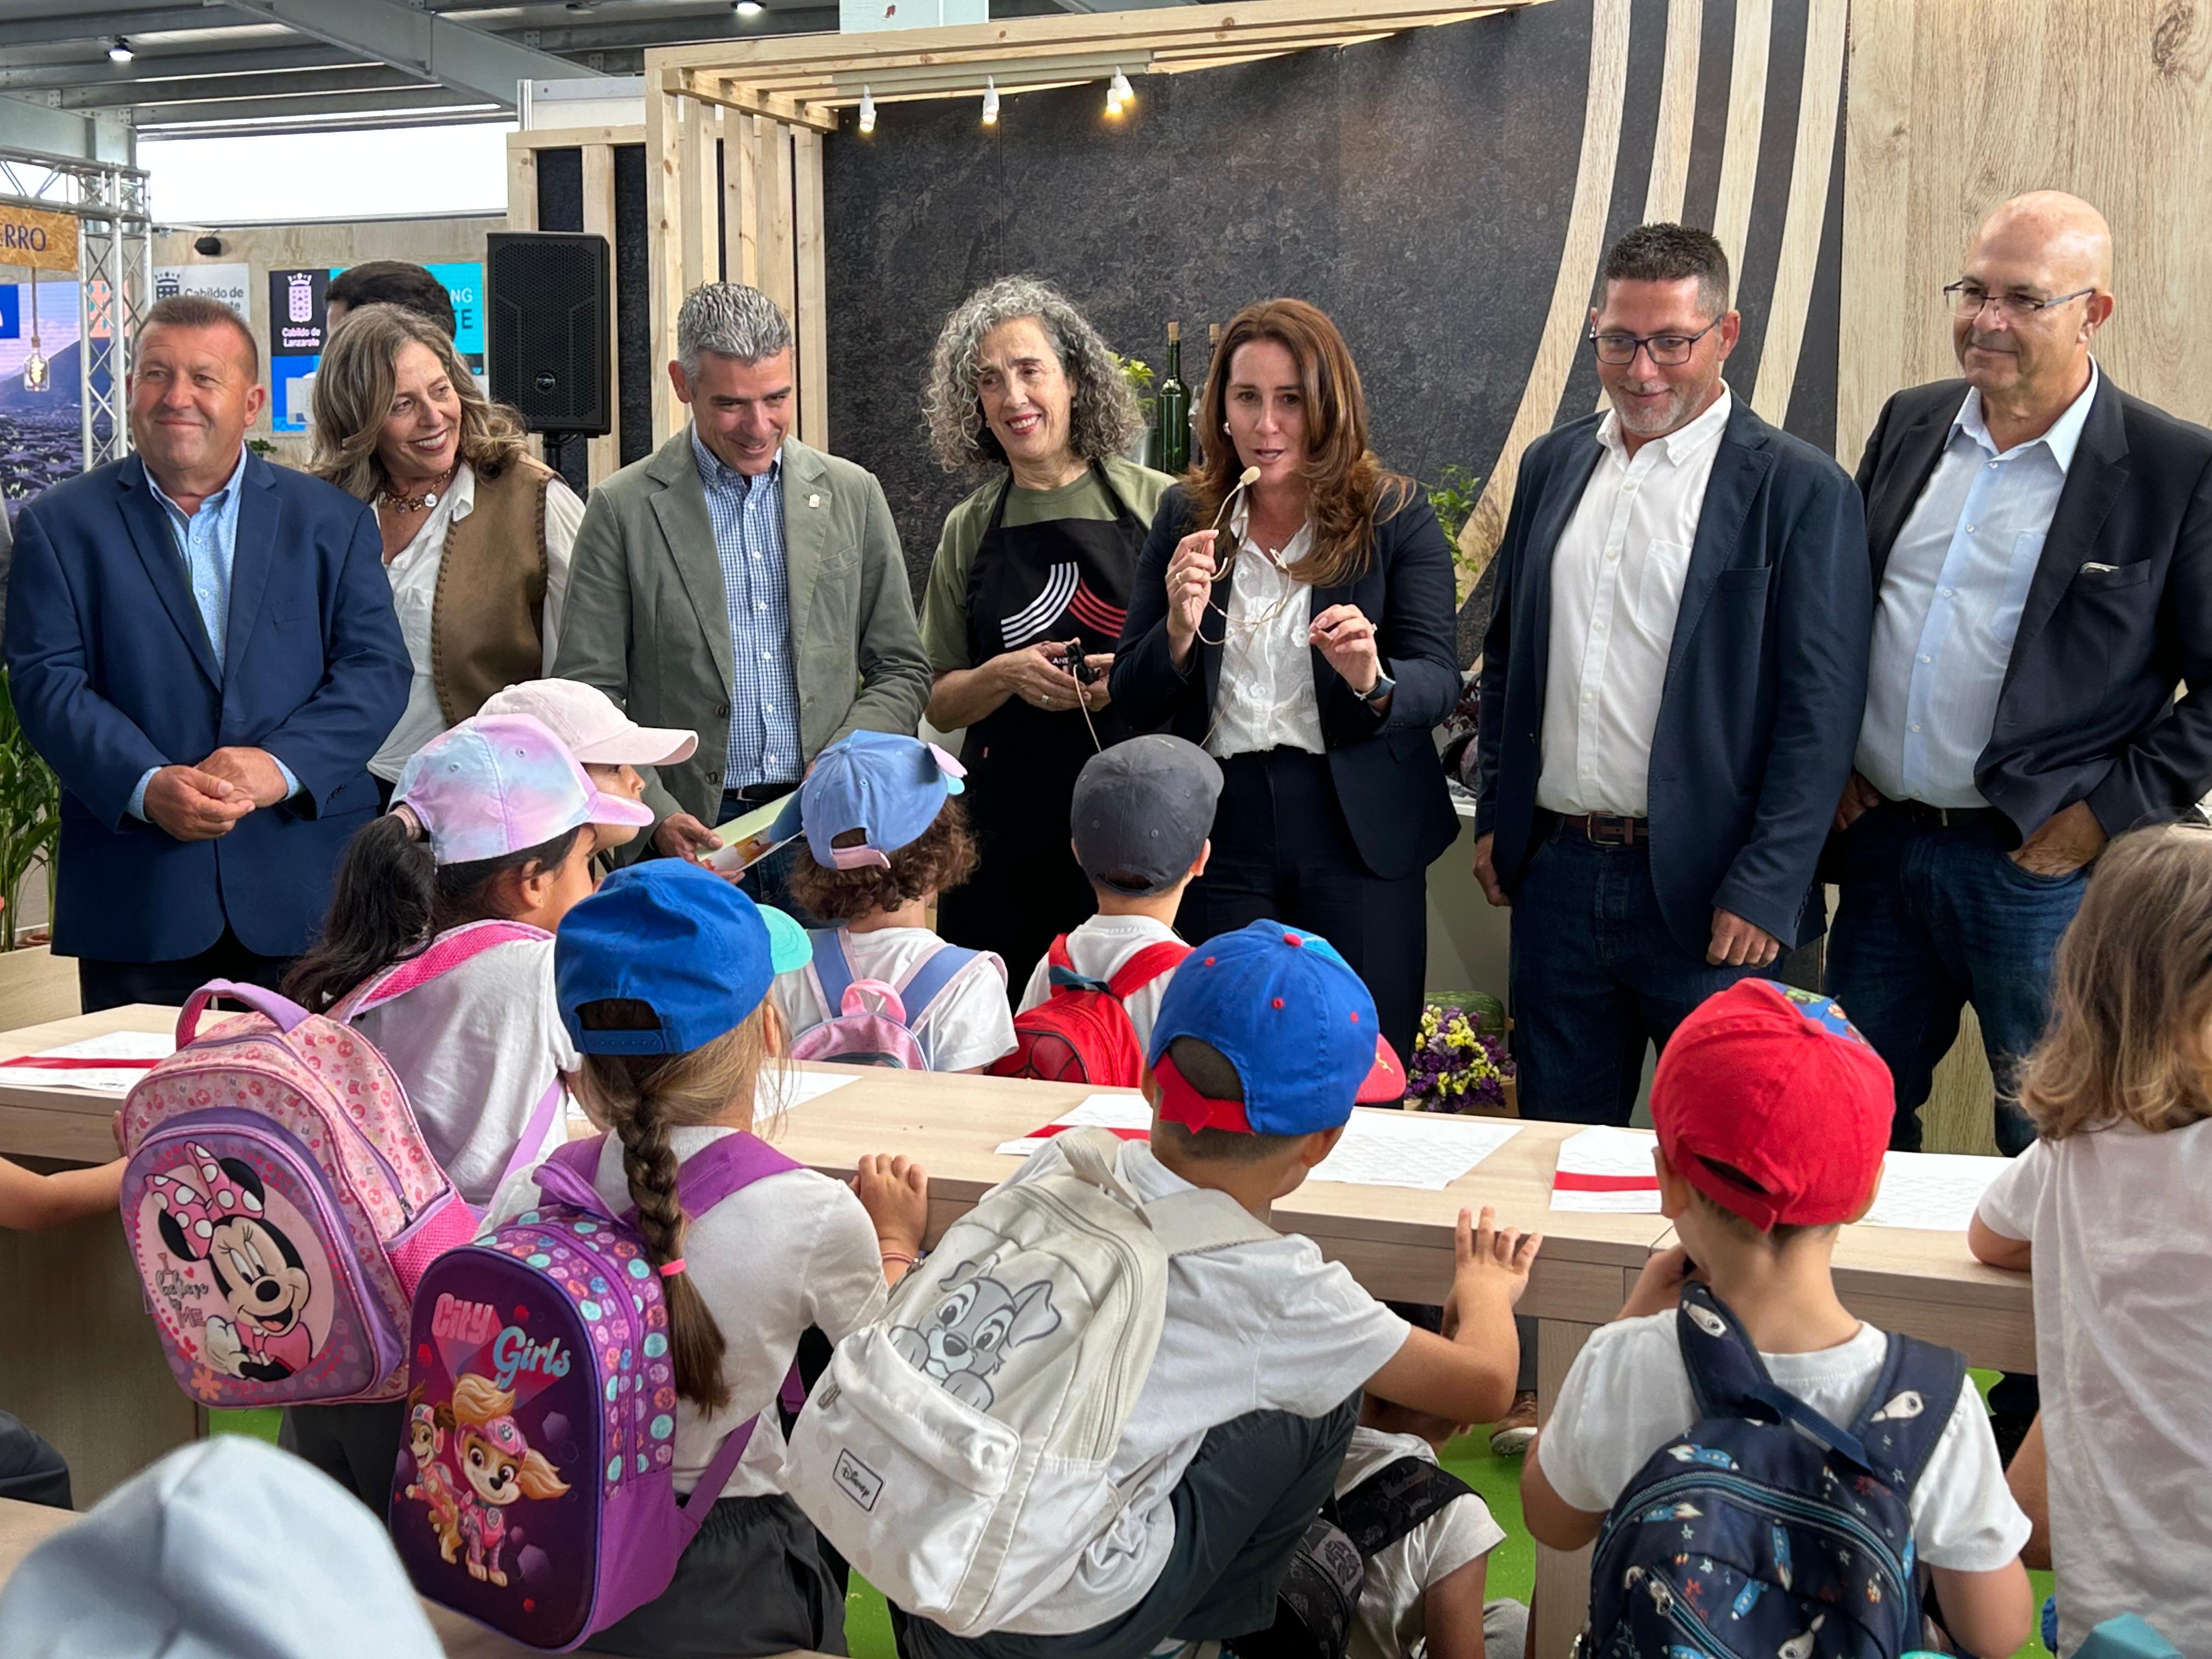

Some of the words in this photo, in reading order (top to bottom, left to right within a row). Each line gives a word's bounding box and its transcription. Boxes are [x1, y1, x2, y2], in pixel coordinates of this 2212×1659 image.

[0, 223, 46, 251] RRO
[185, 287, 227, 298] Cabildo
[229, 286, 244, 298] de
[450, 287, 473, 303] NG
[493, 1325, 571, 1389] Girls
[842, 1459, 870, 1499] Disney
